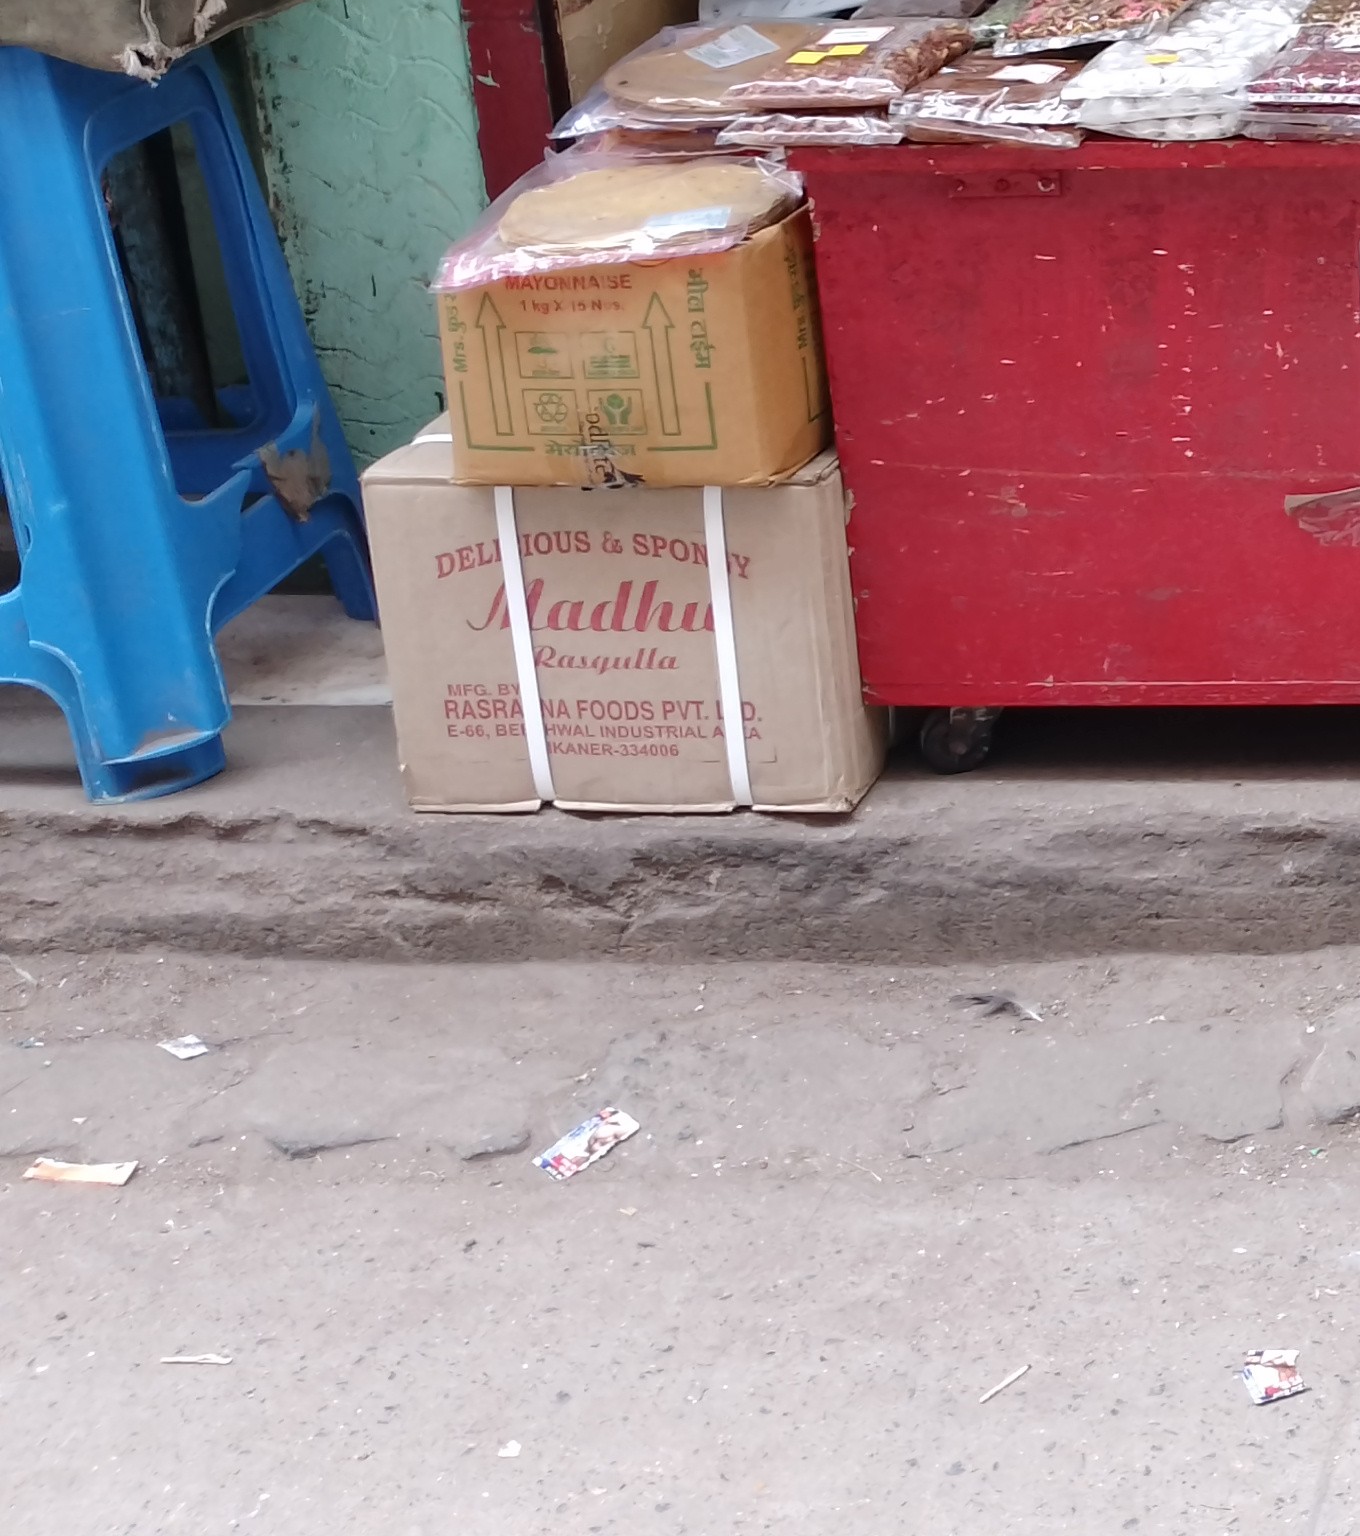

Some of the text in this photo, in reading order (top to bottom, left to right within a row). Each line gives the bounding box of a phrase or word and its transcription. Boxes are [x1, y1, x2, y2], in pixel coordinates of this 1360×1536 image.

[505, 273, 633, 292] MAYONNAISE
[531, 298, 550, 315] kg
[435, 530, 592, 579] DELIIOUS
[601, 530, 623, 555] &
[532, 645, 680, 676] Rasgulla
[447, 683, 522, 698] MFG. BY
[443, 699, 763, 724] RASRANA FOODS PVT. LD.
[600, 724, 707, 740] INDUSTRIAL
[712, 725, 762, 741] AA
[546, 741, 681, 757] IKANER-334006
